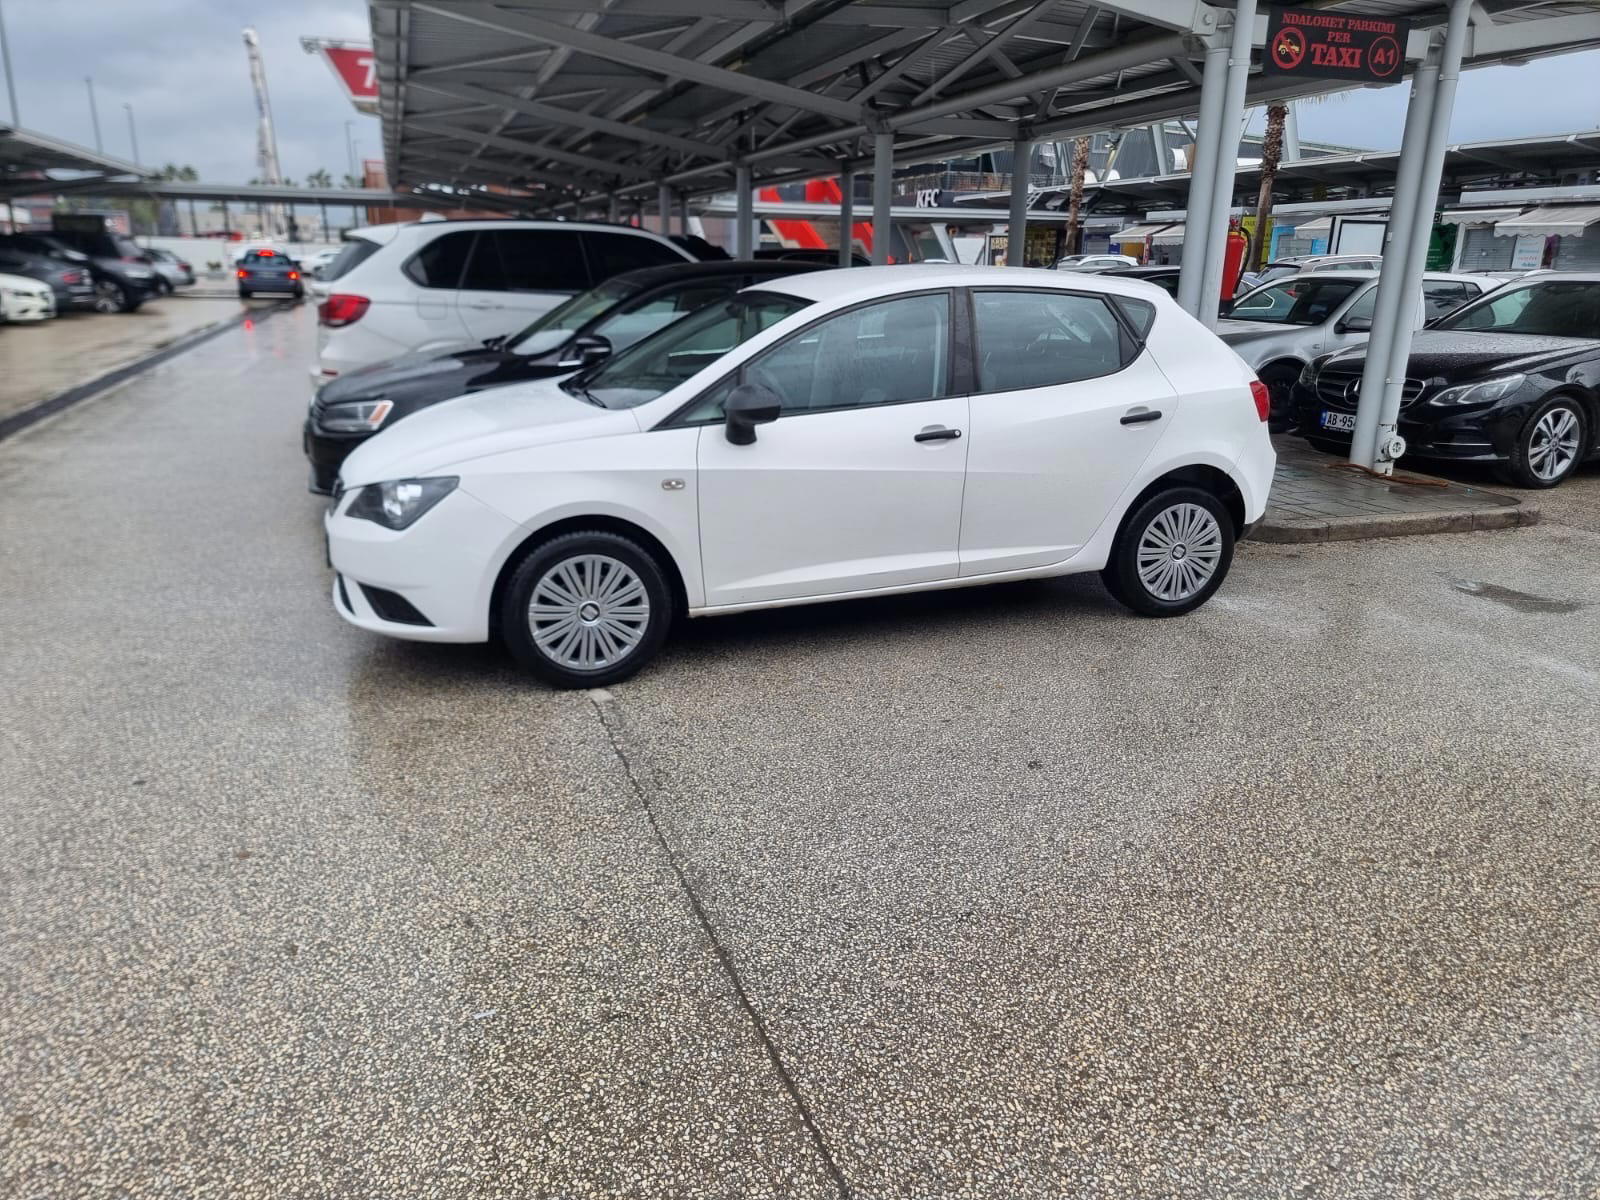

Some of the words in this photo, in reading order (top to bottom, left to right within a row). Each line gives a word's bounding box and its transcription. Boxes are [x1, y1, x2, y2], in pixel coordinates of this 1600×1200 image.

[1282, 12, 1345, 29] NDALOHET
[1347, 18, 1396, 34] PARKIMI
[1327, 31, 1352, 44] PER
[1310, 43, 1364, 69] TAXI
[1373, 50, 1394, 65] A1
[915, 188, 940, 209] KFC
[1326, 413, 1338, 426] AB
